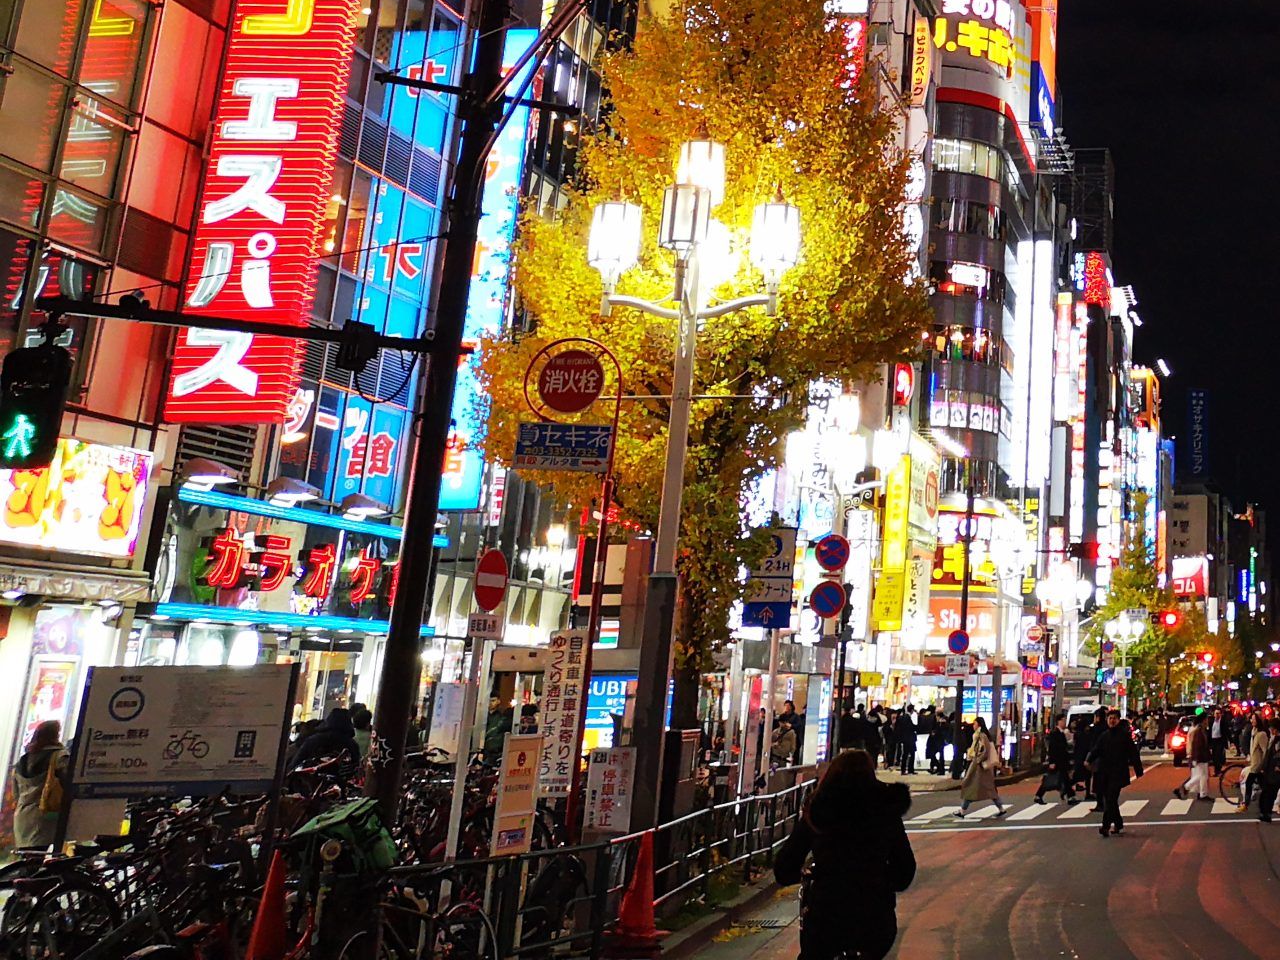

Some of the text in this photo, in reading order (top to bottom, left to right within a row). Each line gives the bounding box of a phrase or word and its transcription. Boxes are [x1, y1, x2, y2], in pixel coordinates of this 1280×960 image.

[171, 76, 302, 398] エスパス
[543, 368, 600, 394] 消火栓
[207, 526, 402, 610] カラオケ
[554, 636, 584, 776] 自転車は車道寄りを
